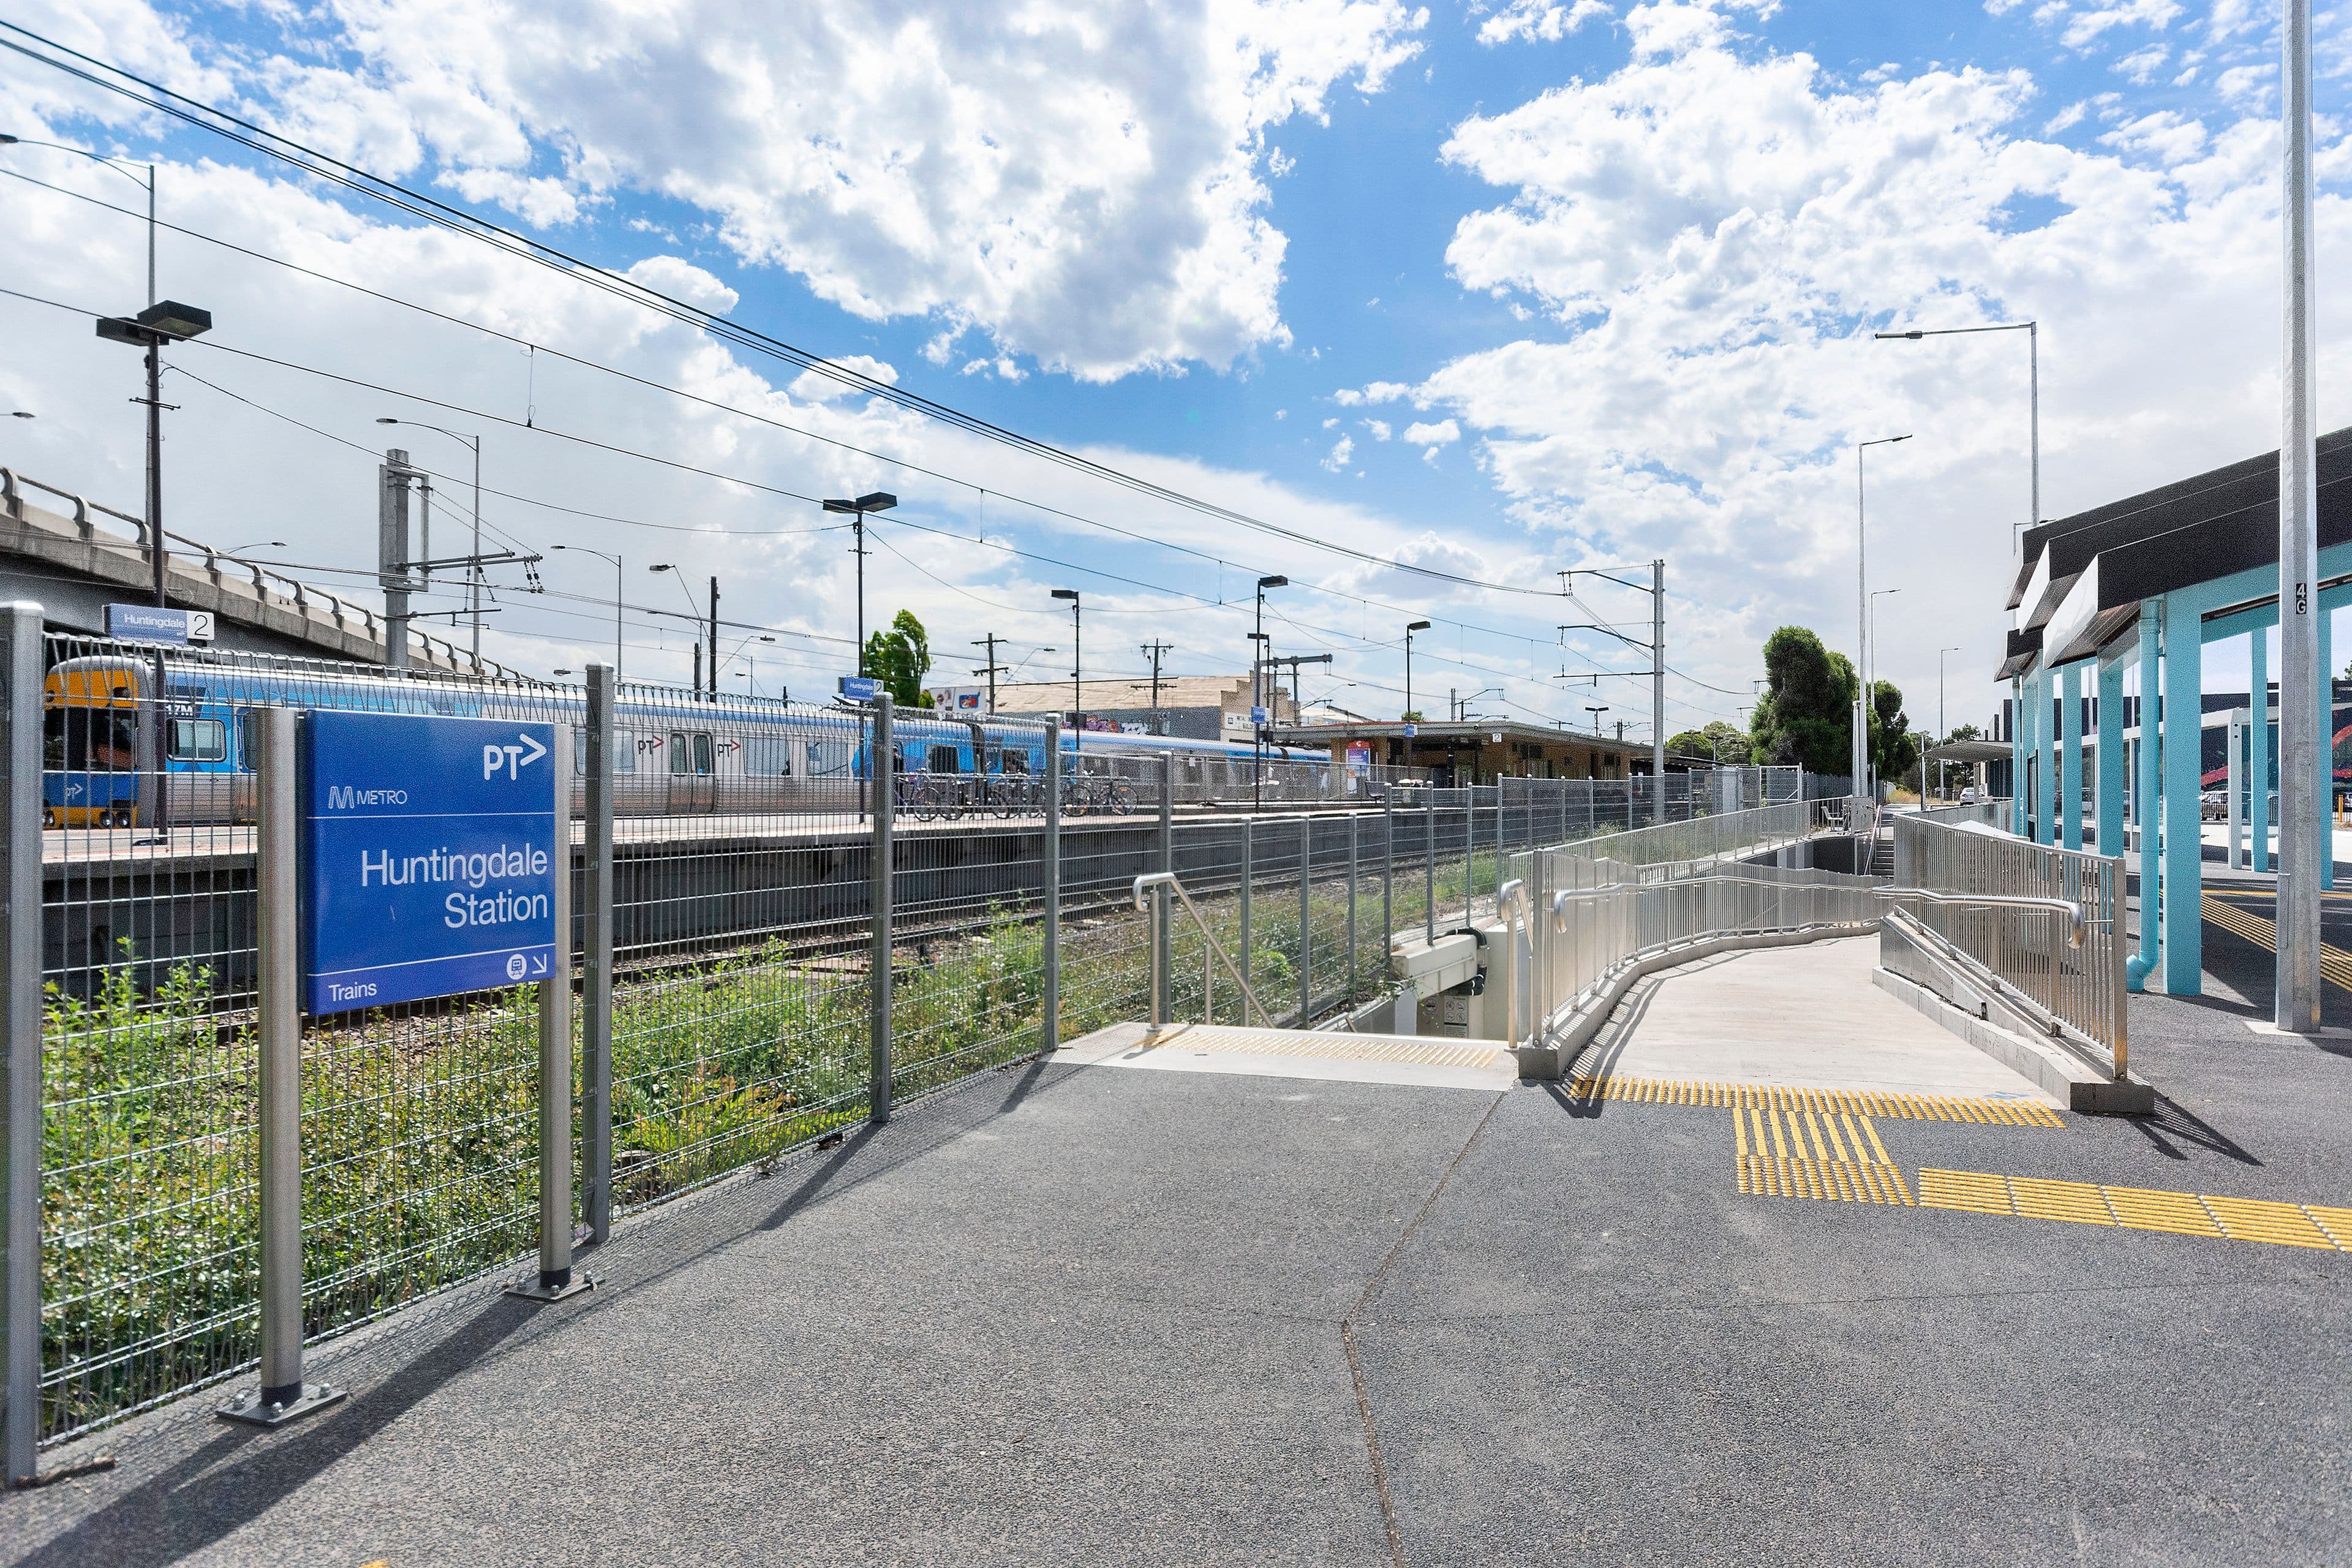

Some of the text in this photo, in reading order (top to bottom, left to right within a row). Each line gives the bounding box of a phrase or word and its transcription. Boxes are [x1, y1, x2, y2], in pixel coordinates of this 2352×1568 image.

[124, 614, 208, 636] Huntingdale 2
[356, 790, 408, 805] METRO
[362, 843, 548, 889] Huntingdale
[444, 889, 548, 929] Station
[328, 982, 377, 1002] Trains
